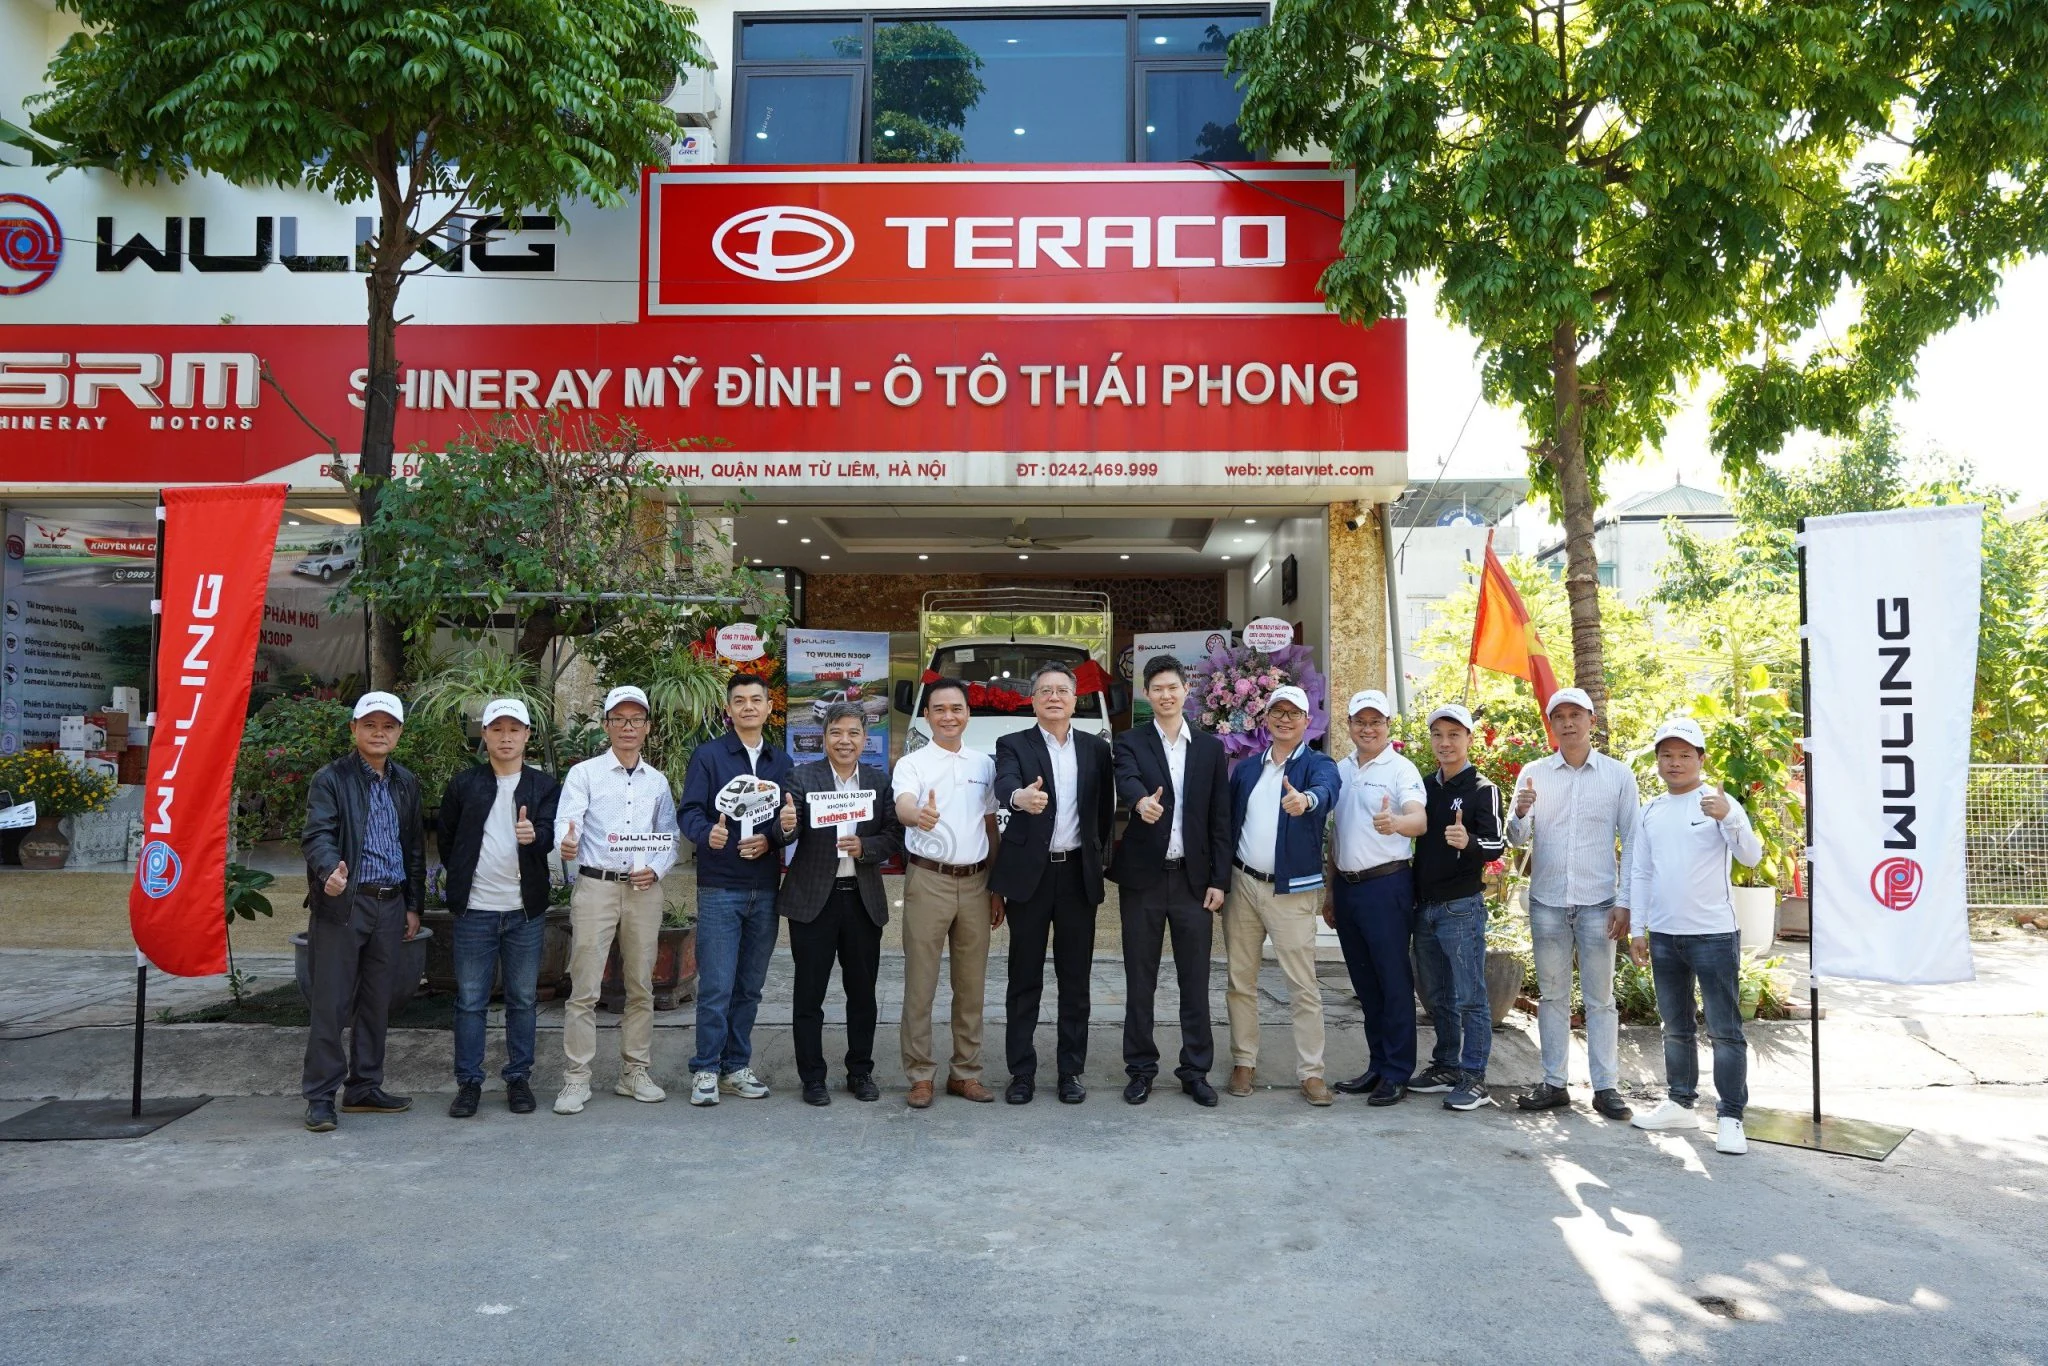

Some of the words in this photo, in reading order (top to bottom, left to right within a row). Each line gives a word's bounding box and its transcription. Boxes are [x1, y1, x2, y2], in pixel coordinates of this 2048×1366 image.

[96, 216, 556, 272] WULING
[885, 215, 1287, 269] TERACO
[0, 352, 260, 409] SRM
[347, 367, 613, 410] SHINERAY
[624, 354, 704, 410] MỸ
[713, 352, 842, 408] ĐÌNH
[883, 352, 923, 408] Ô
[935, 351, 1008, 408] TÔ
[1020, 351, 1146, 407] THÁI
[1162, 361, 1359, 408] PHONG
[0, 415, 107, 430] HINERAY
[150, 415, 253, 431] MOTORS
[711, 461, 758, 482] QUẬN
[764, 464, 801, 478] NAM
[808, 460, 832, 478] TỪ
[838, 461, 880, 479] LIÊM,
[888, 461, 911, 477] HÀ
[917, 460, 946, 480] NỘI
[1225, 464, 1263, 477] web:
[1266, 464, 1375, 477] xetaiviet.com
[127, 571, 150, 579] 0989
[259, 629, 293, 648] N300P
[81, 642, 94, 653] GM
[806, 651, 816, 659] TQ
[817, 651, 847, 659] WULING
[847, 652, 871, 660] N300P
[150, 574, 224, 834] WULING
[1876, 597, 1917, 850] WULING
[810, 793, 820, 801] TQ
[820, 792, 849, 800] WULING
[850, 791, 873, 799] N300P
[754, 800, 779, 815] WULING
[849, 806, 867, 819] THẾ
[752, 812, 772, 824] N300P
